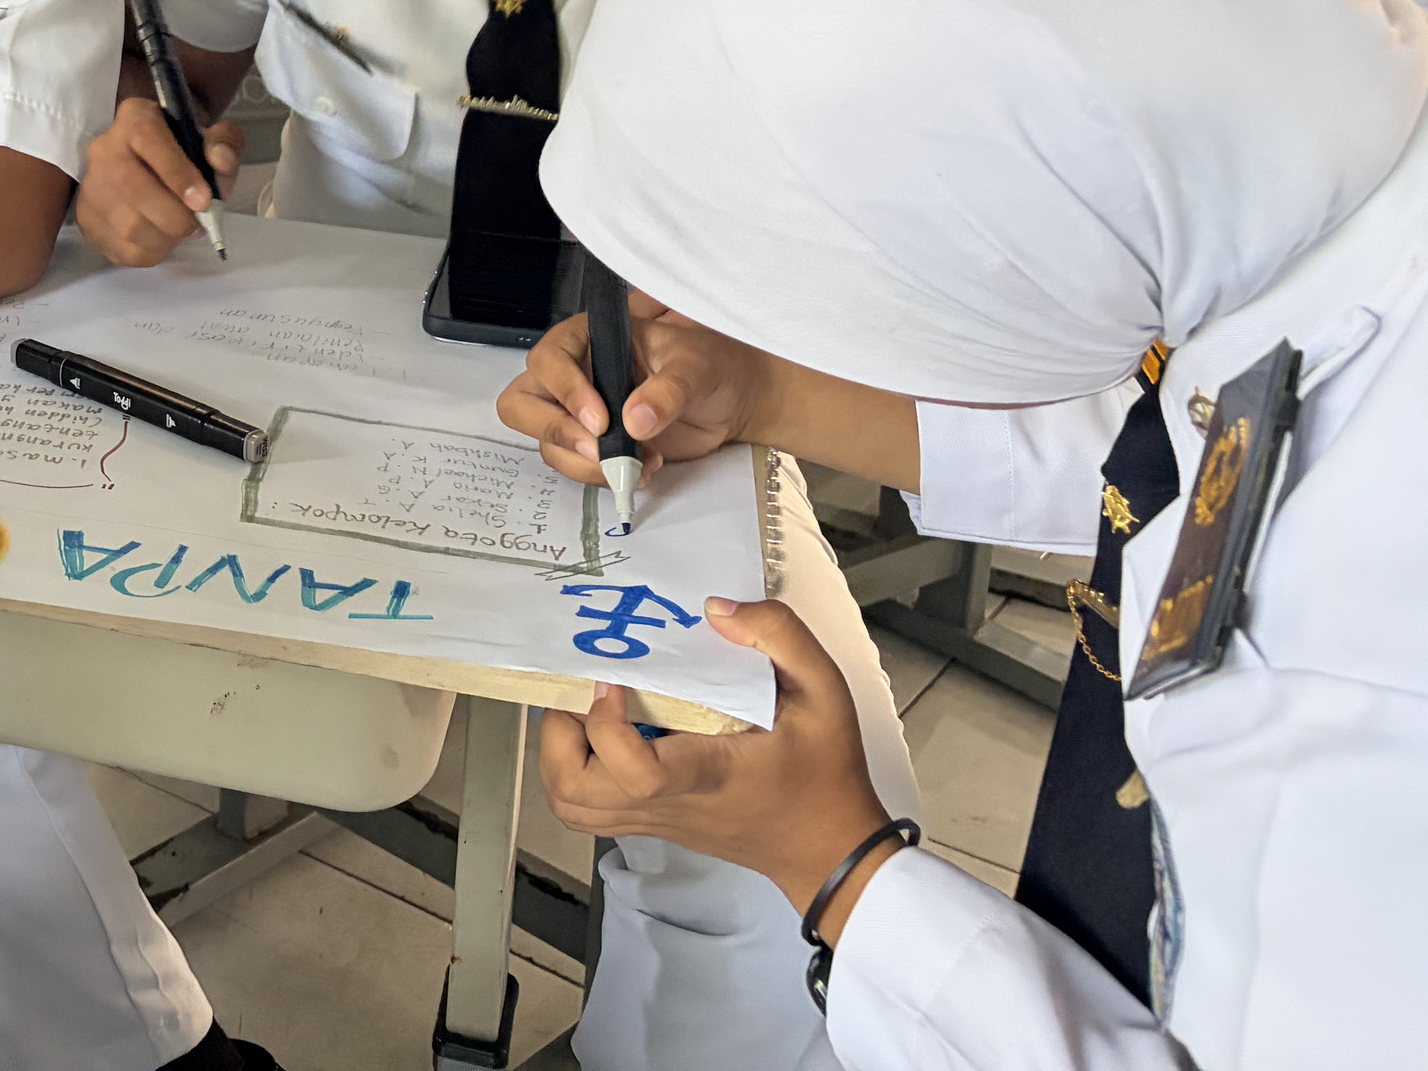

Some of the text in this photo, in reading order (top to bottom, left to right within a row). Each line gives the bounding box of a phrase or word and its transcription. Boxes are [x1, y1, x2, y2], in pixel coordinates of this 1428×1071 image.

[0, 419, 98, 439] tentang
[436, 468, 514, 489] Michael
[453, 482, 513, 499] Mario
[442, 525, 567, 561] Anggota
[57, 529, 433, 620] TANPA
